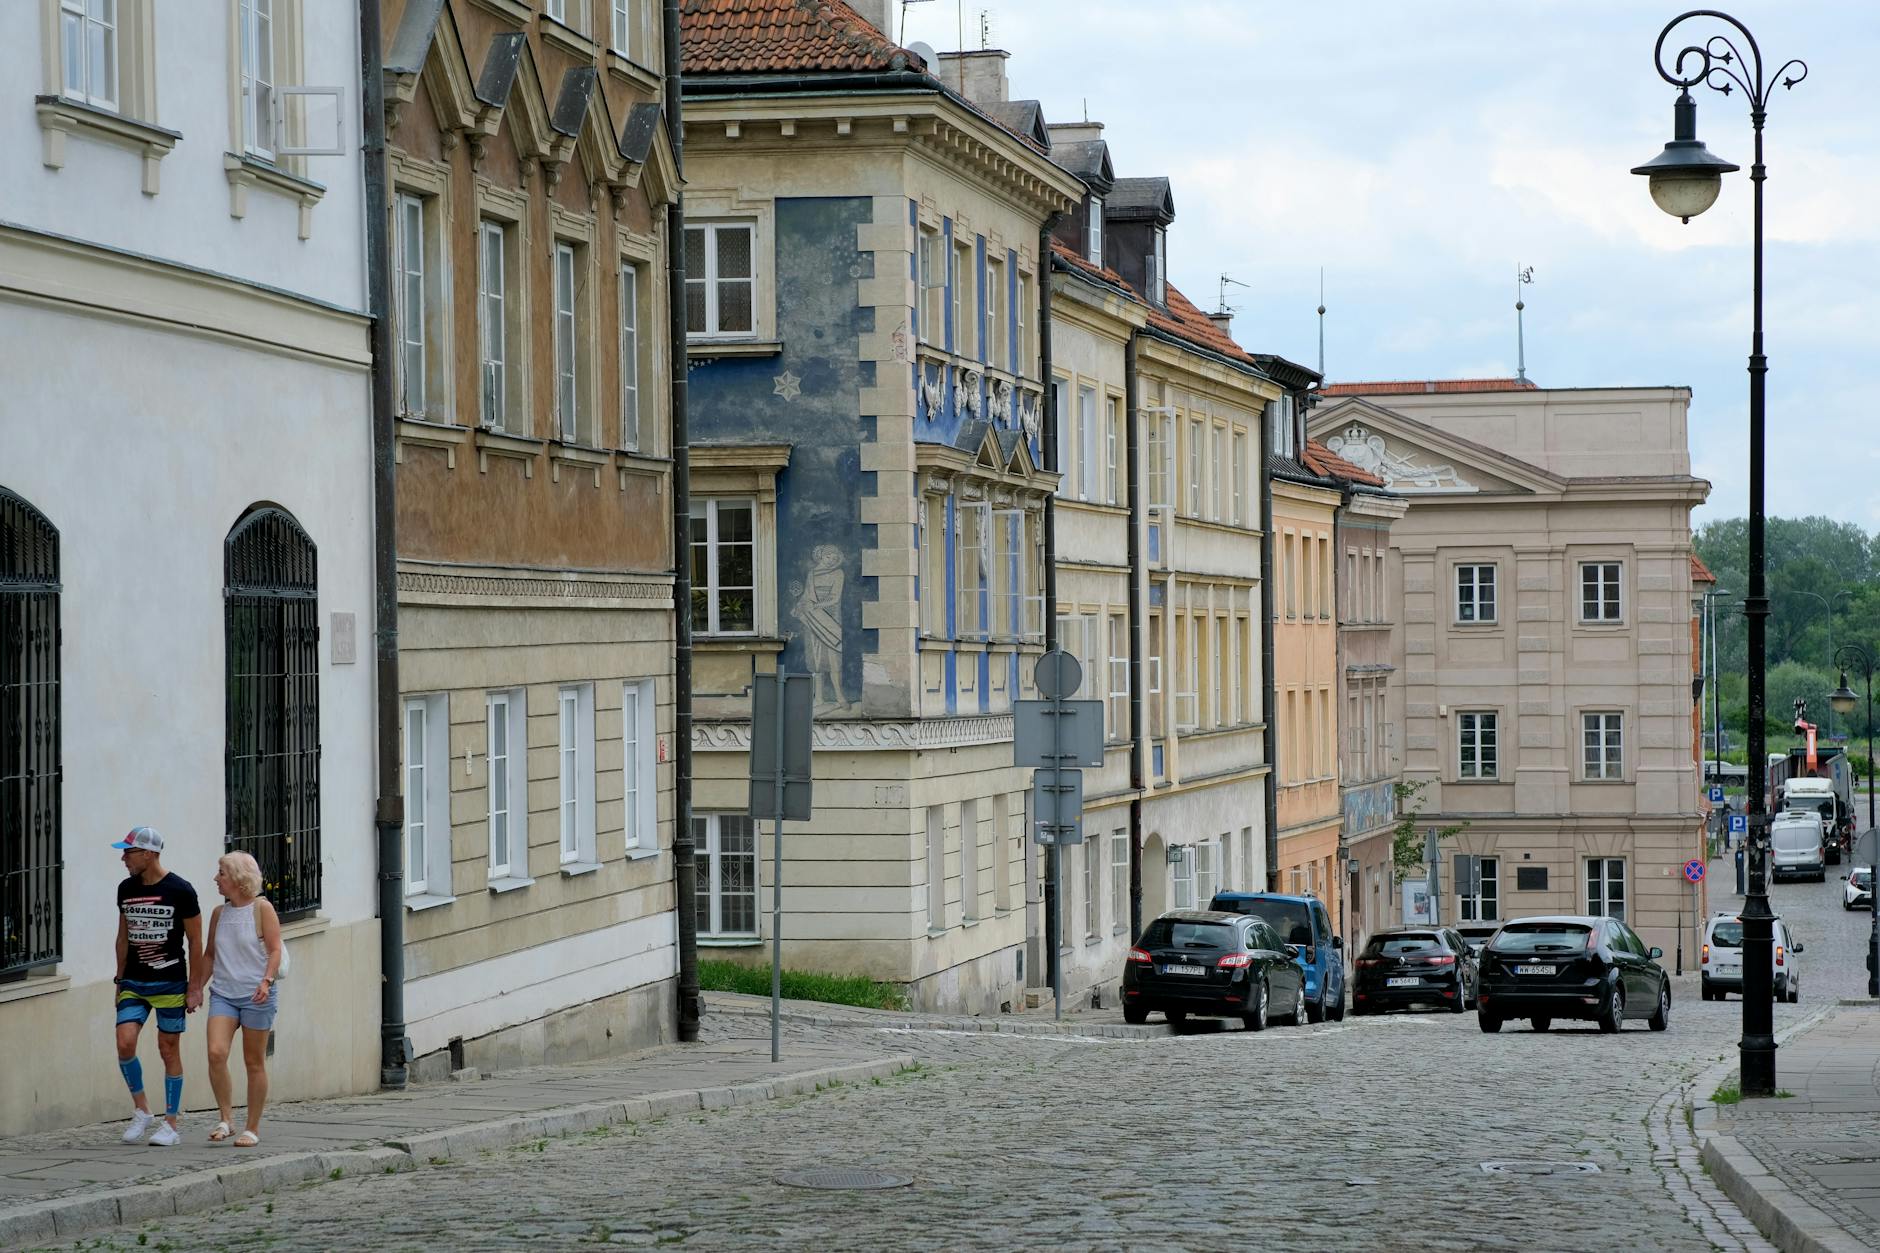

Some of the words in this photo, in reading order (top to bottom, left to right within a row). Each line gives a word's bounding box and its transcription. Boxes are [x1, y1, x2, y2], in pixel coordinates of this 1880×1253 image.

[1711, 788, 1721, 801] P
[1732, 816, 1743, 831] P
[122, 906, 172, 916] SQUARED2
[152, 920, 171, 928] Roll
[1520, 966, 1529, 974] WW
